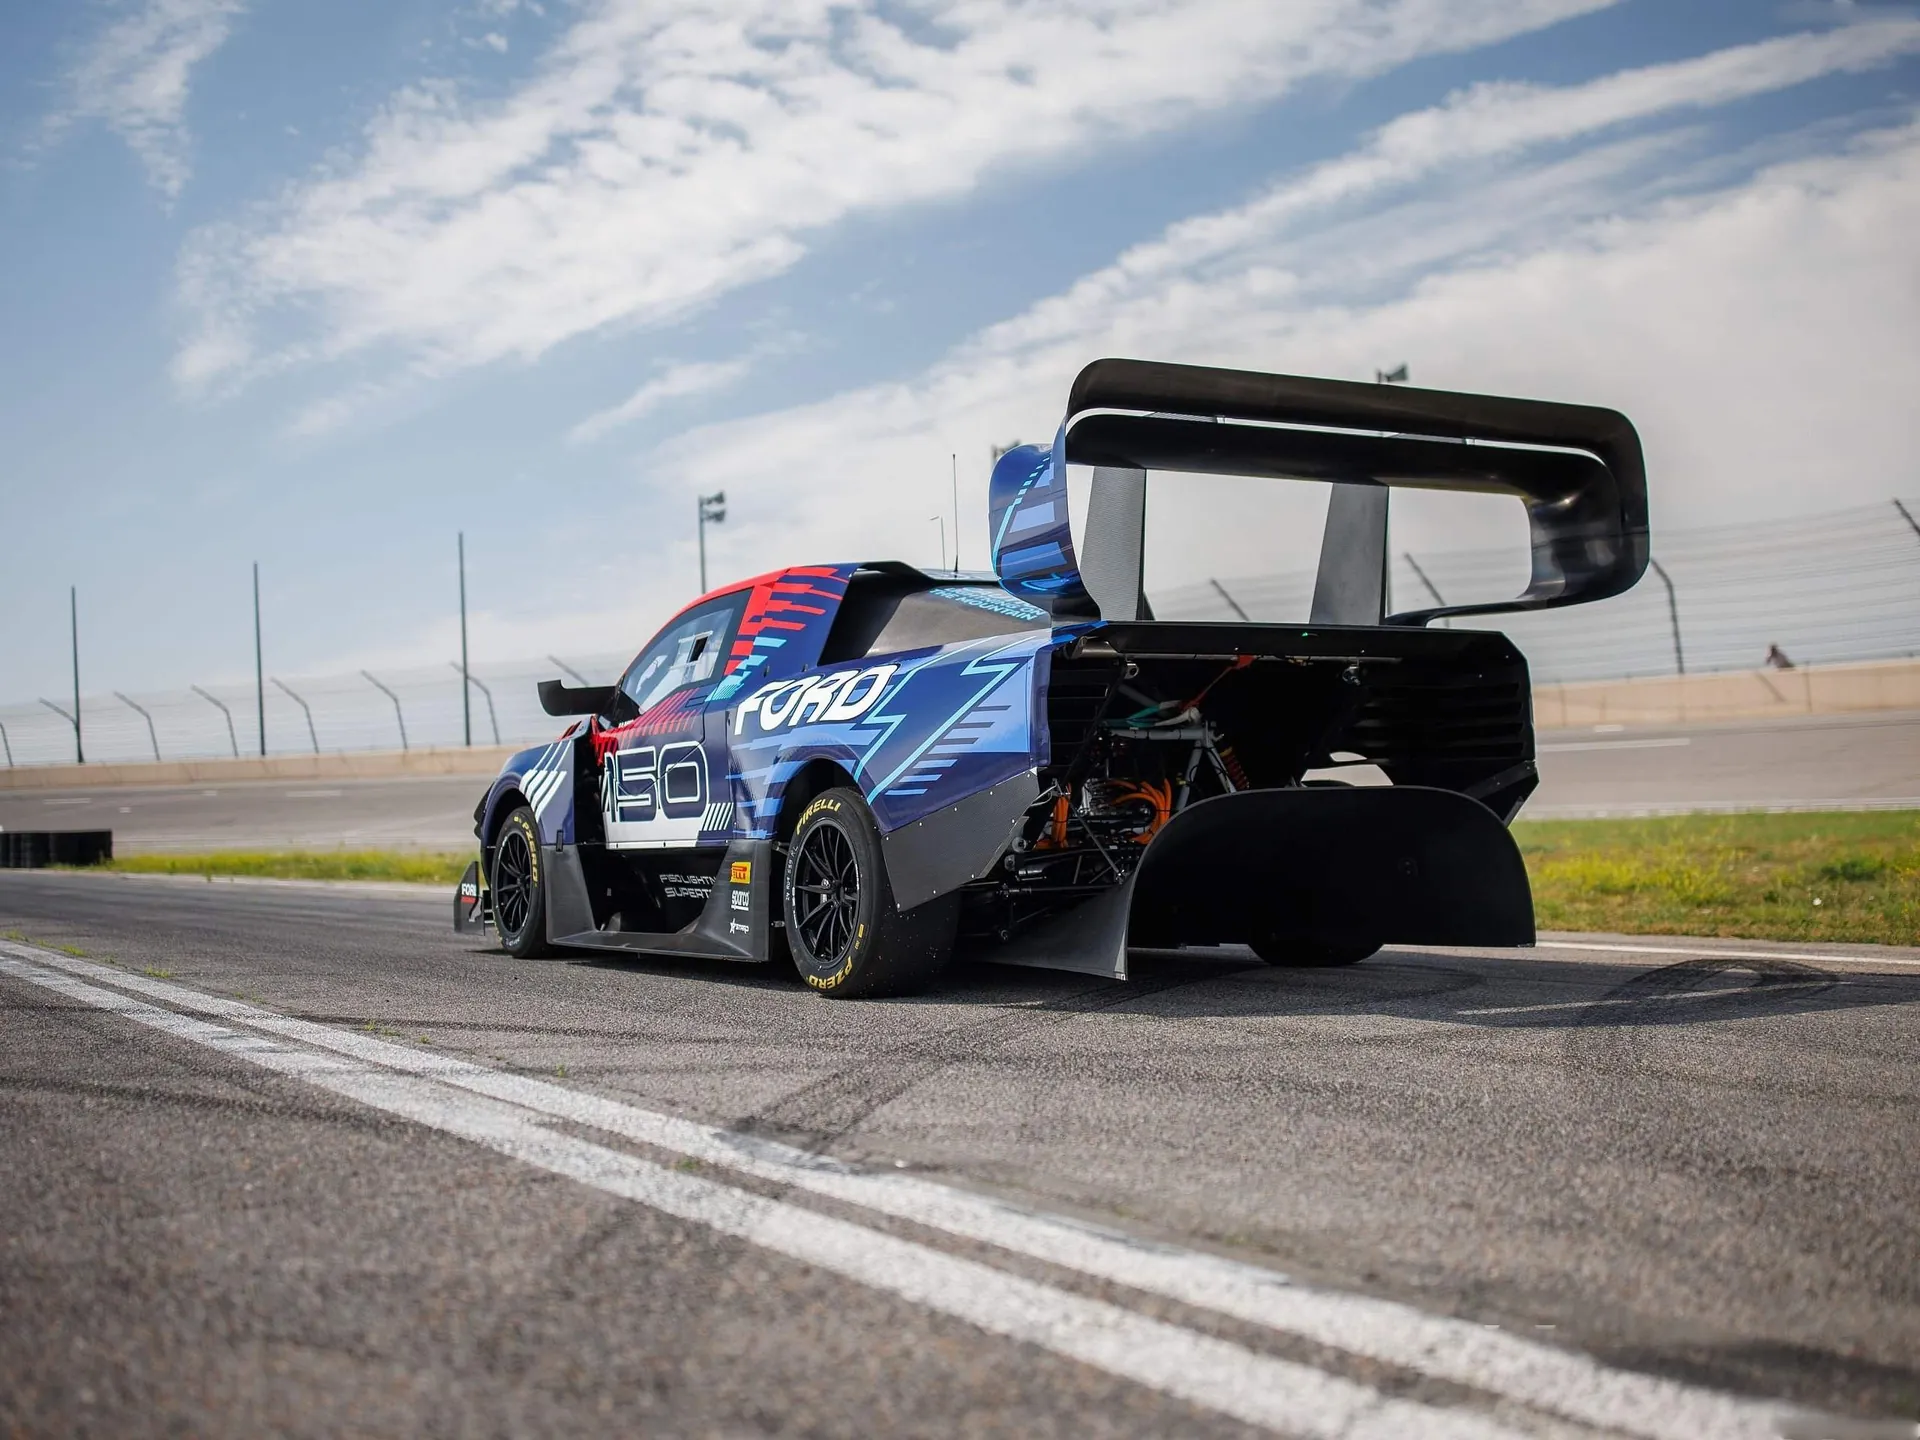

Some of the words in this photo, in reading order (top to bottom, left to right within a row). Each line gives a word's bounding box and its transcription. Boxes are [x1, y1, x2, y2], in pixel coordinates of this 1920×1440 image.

[957, 595, 1038, 621] MOUNTAIN
[733, 663, 900, 736] FORD
[795, 798, 842, 836] PIRELLI
[664, 887, 712, 899] SUPERT
